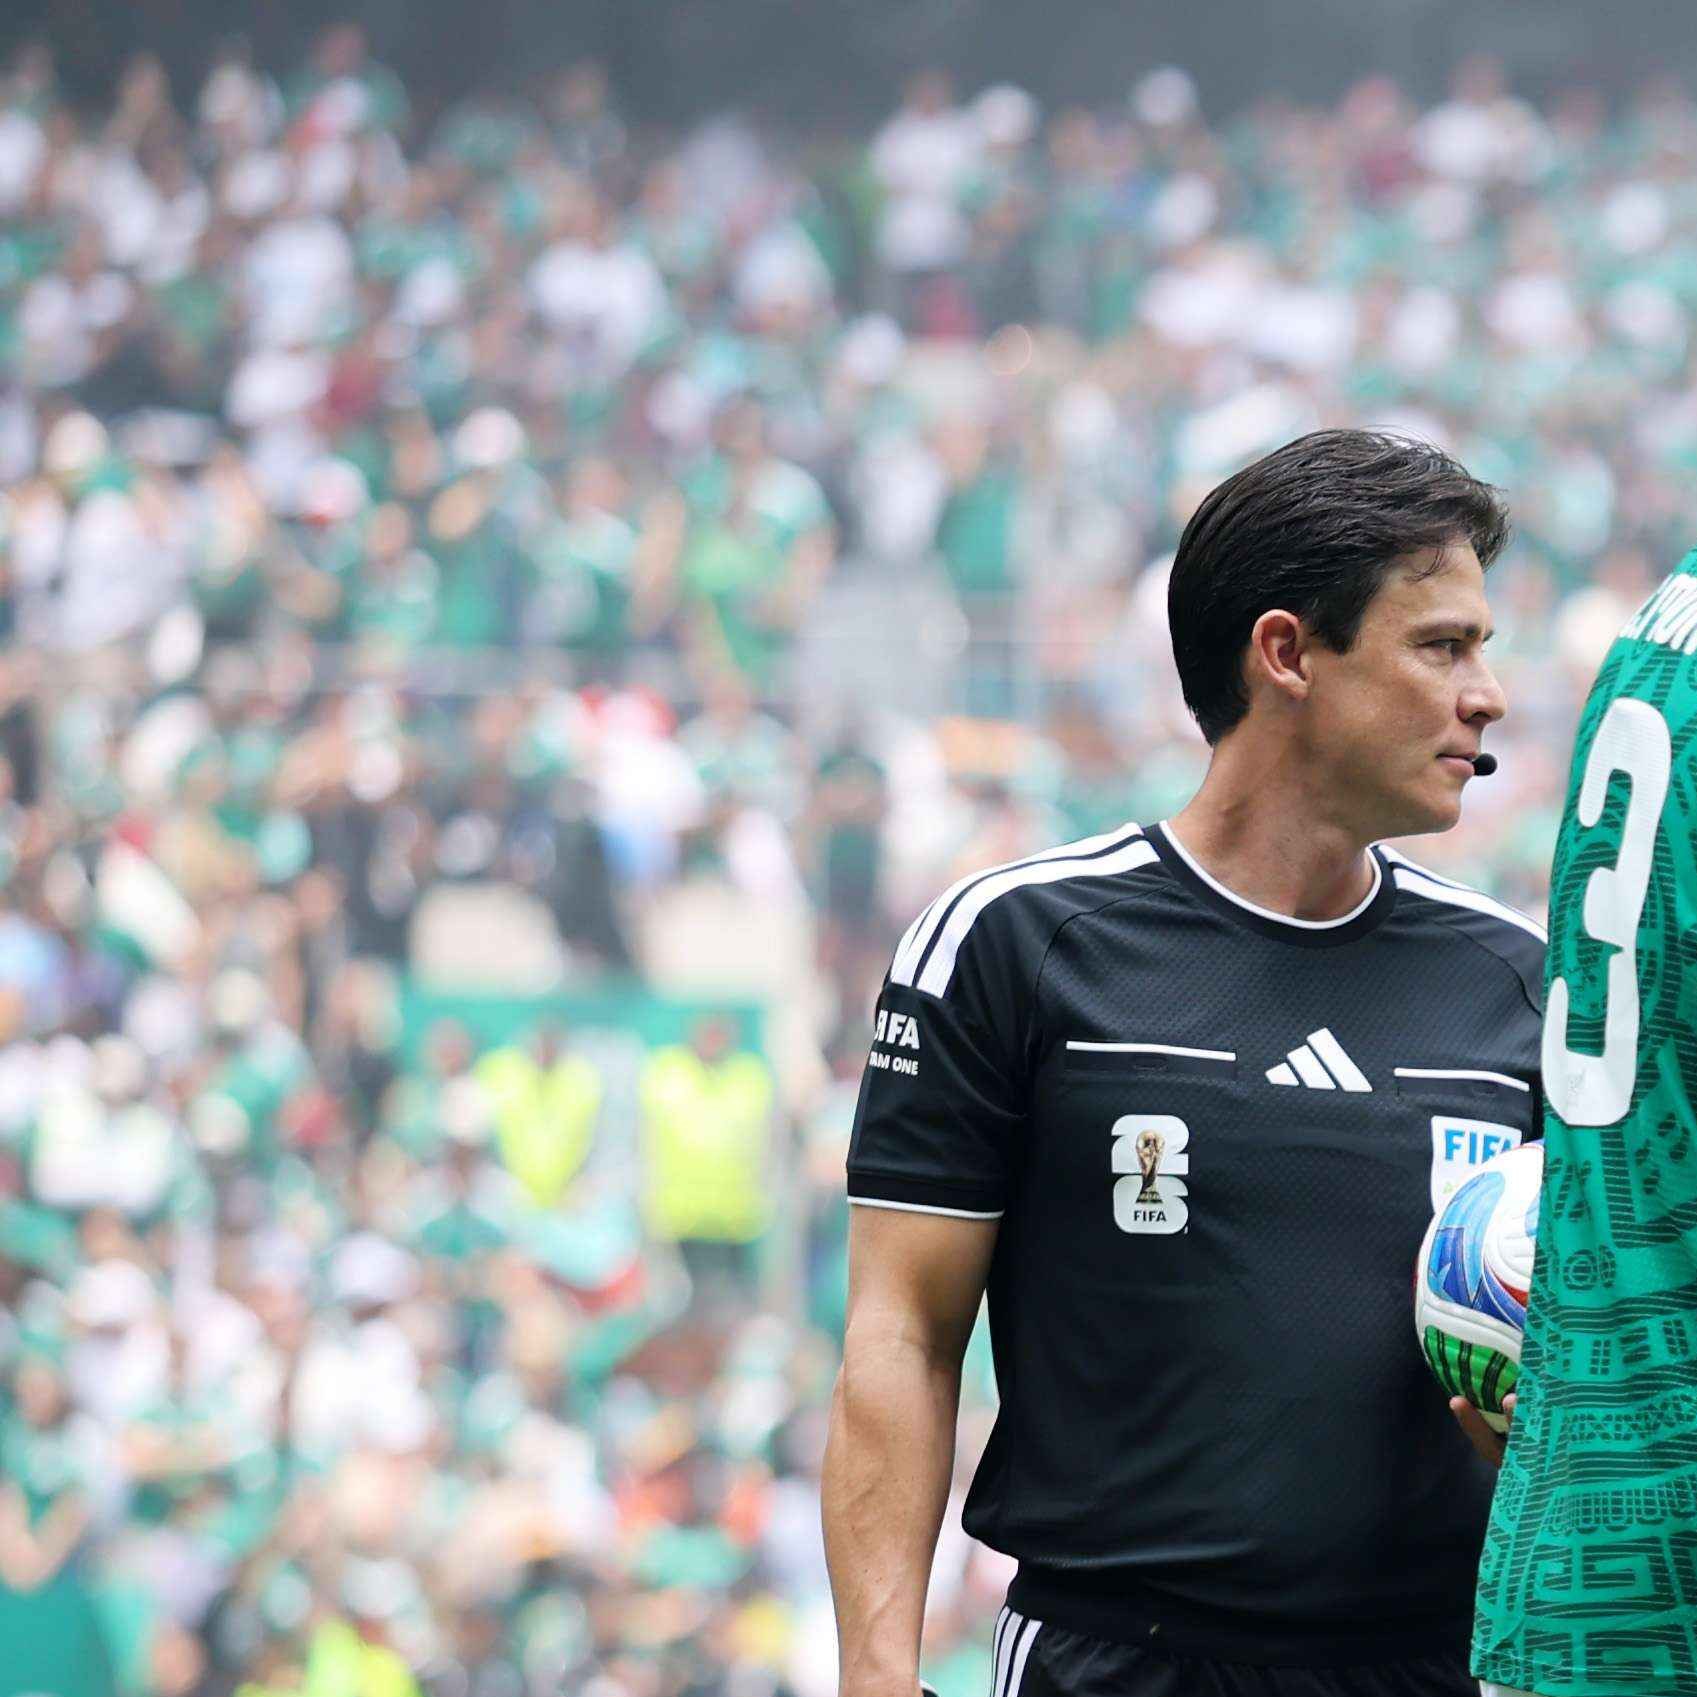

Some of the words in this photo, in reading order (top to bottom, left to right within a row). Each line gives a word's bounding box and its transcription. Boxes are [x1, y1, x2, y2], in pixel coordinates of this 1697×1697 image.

[1542, 697, 1671, 1126] 3
[873, 1009, 920, 1050] IFA
[892, 1056, 919, 1076] ONE
[1133, 1209, 1168, 1223] FIFA
